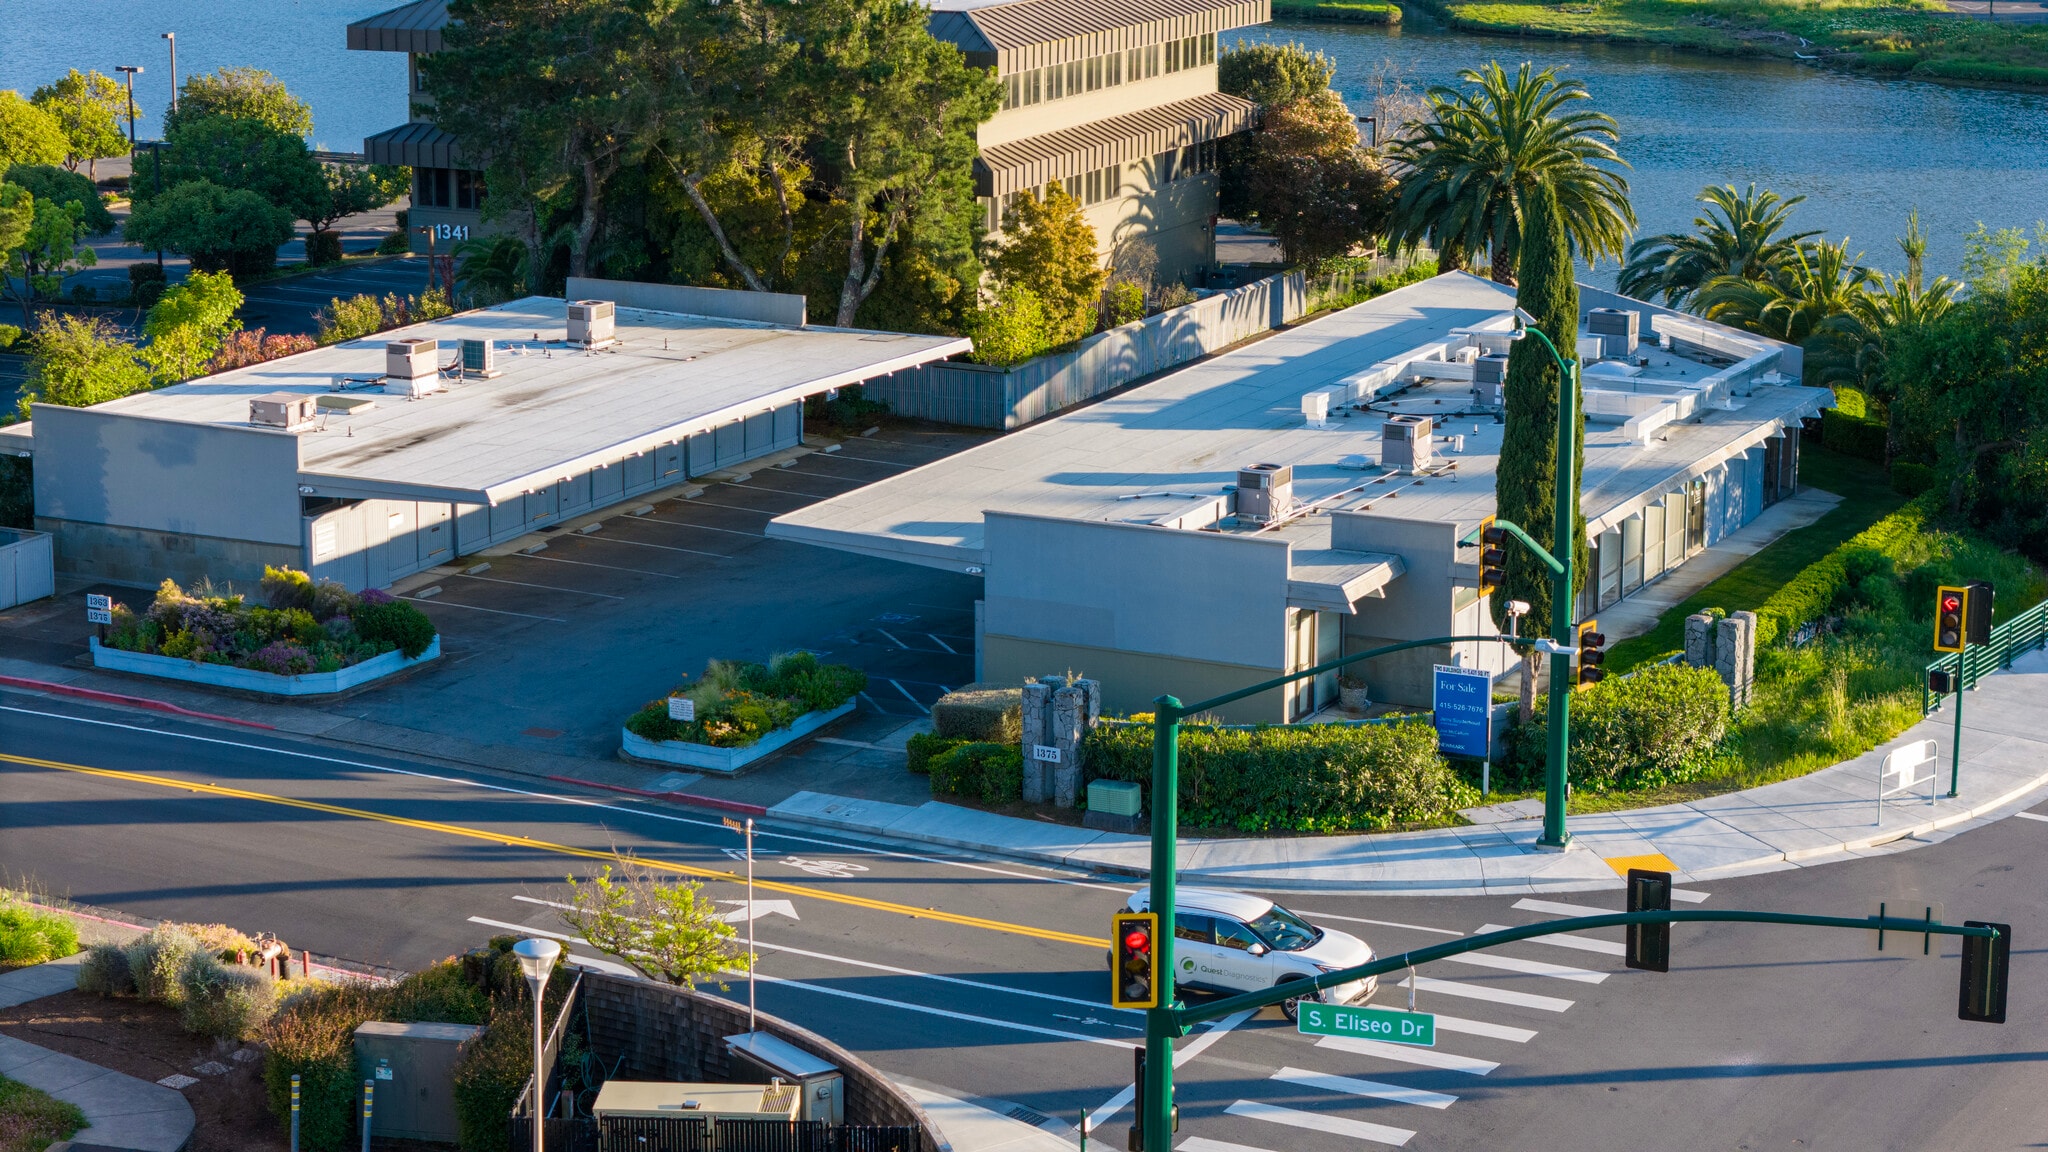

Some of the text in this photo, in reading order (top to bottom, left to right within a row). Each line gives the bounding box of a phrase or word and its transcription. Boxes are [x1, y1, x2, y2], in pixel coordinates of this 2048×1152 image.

[435, 223, 469, 241] 1341
[90, 597, 108, 606] 1363
[1443, 666, 1461, 674] BUILDINGS
[1440, 680, 1476, 693] For Sale
[1440, 702, 1484, 713] 415-526-7676
[1036, 749, 1057, 759] 1375
[1200, 965, 1223, 976] Quest
[1309, 1010, 1425, 1037] S. Eliseo Dr
